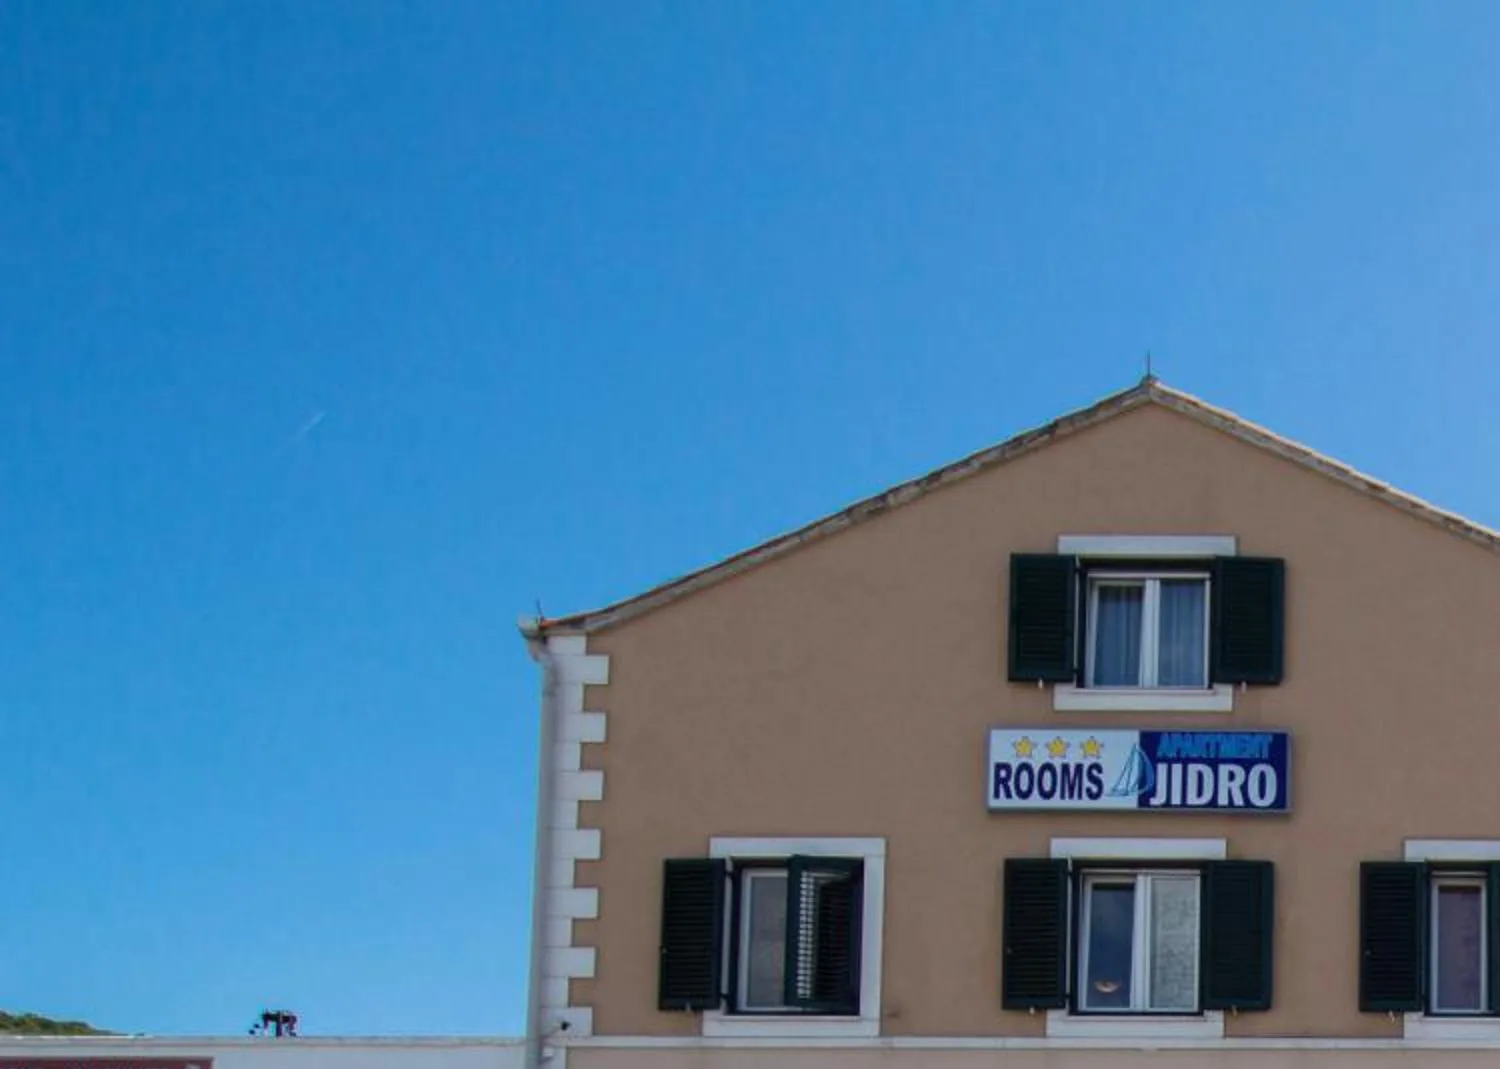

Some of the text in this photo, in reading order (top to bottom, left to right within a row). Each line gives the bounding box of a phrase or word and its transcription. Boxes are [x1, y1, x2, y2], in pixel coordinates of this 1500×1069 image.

[1157, 733, 1273, 759] APARTMENT
[993, 762, 1104, 800] ROOMS
[1150, 762, 1278, 807] JIDRO
